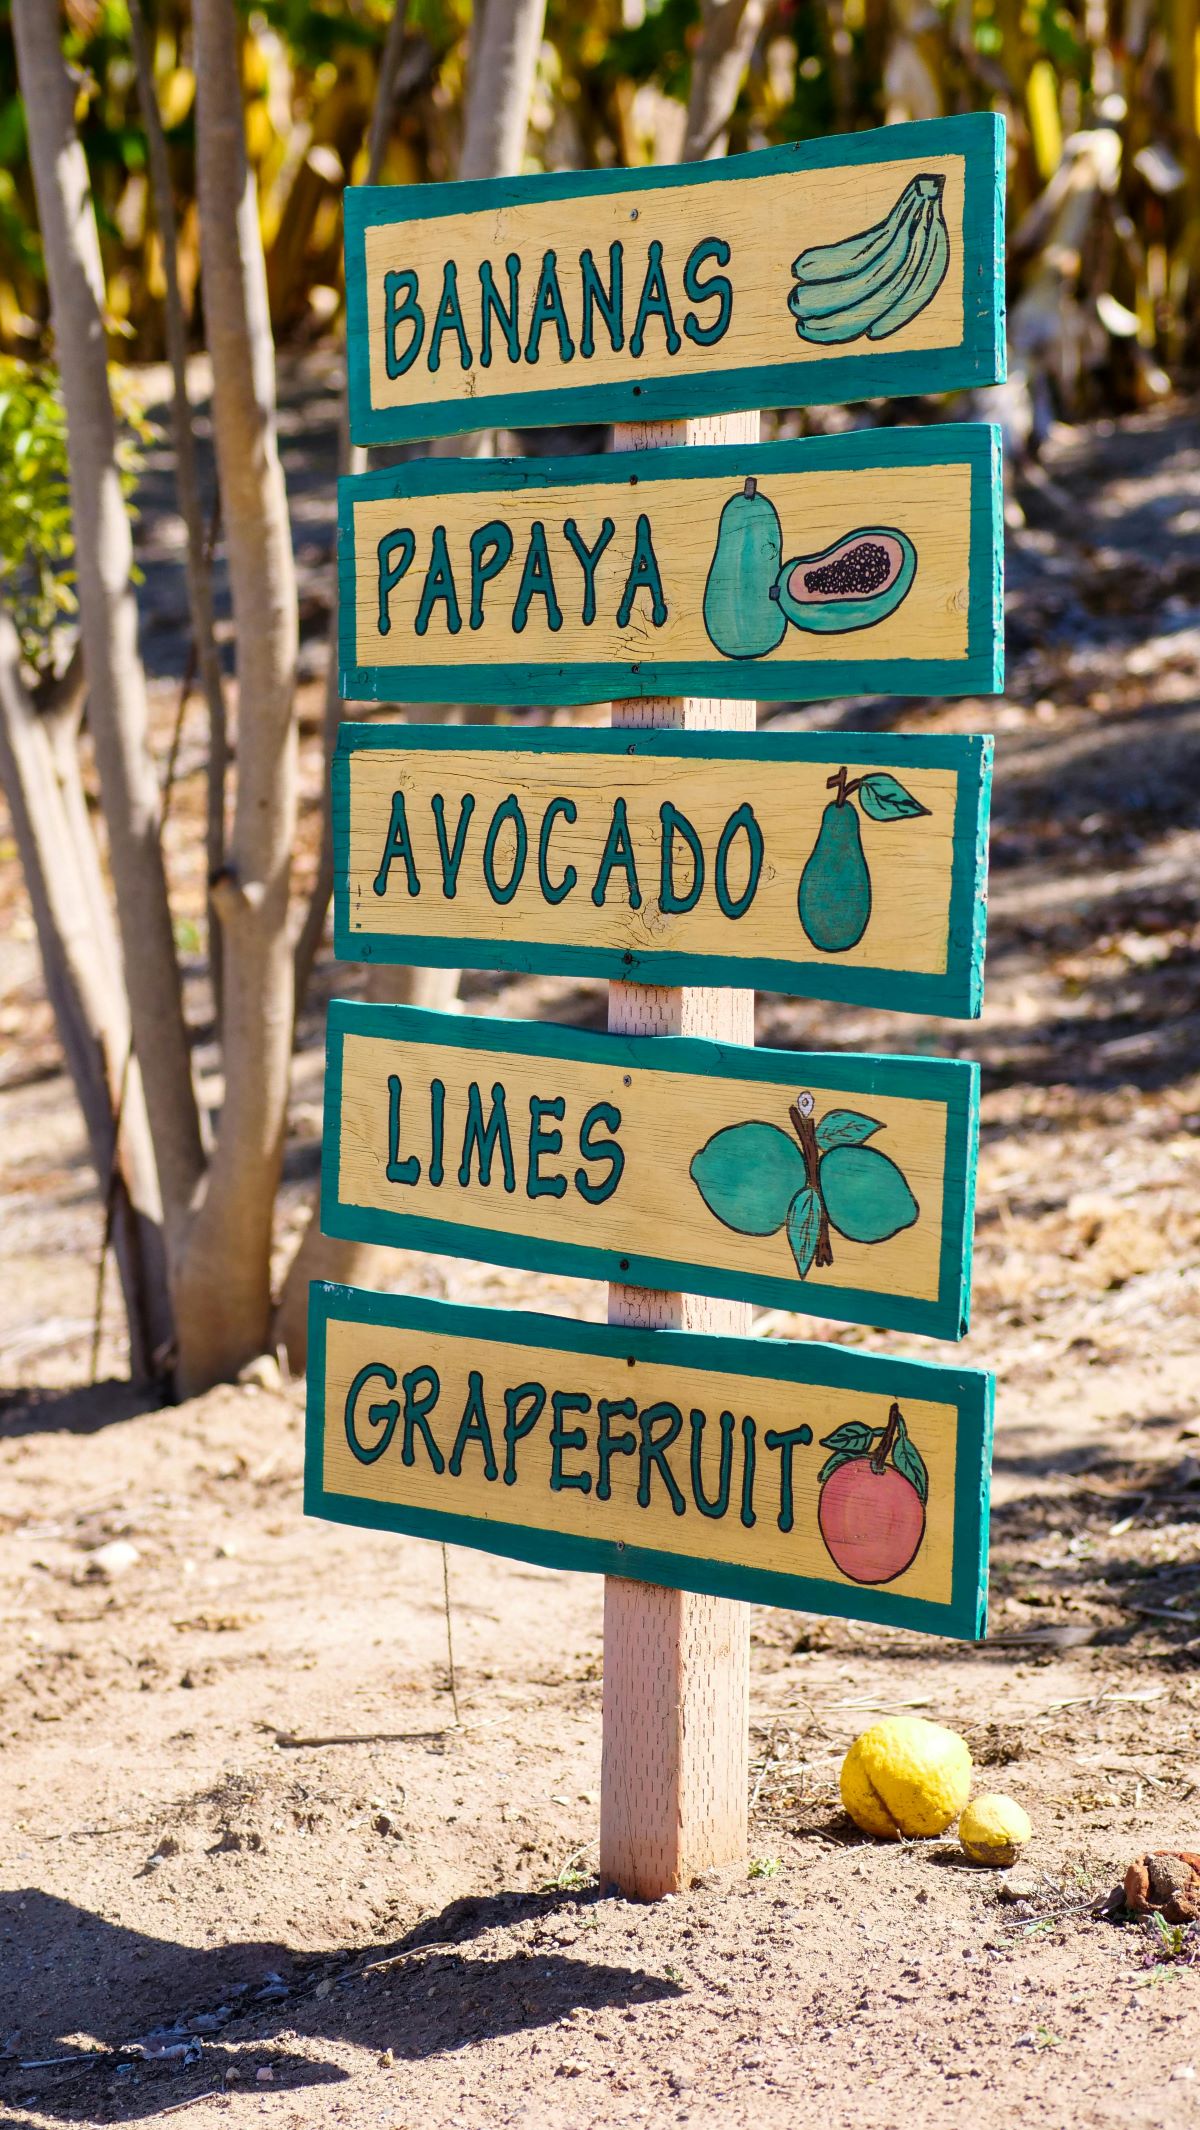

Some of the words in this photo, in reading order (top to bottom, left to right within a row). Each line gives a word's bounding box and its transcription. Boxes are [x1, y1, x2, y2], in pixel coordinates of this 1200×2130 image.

[384, 236, 734, 381] BANANAS
[377, 513, 669, 637] PAPAYA
[371, 790, 765, 921] AVOCADO
[385, 1074, 625, 1206] LIMES
[344, 1361, 813, 1534] GRAPEFRUIT
